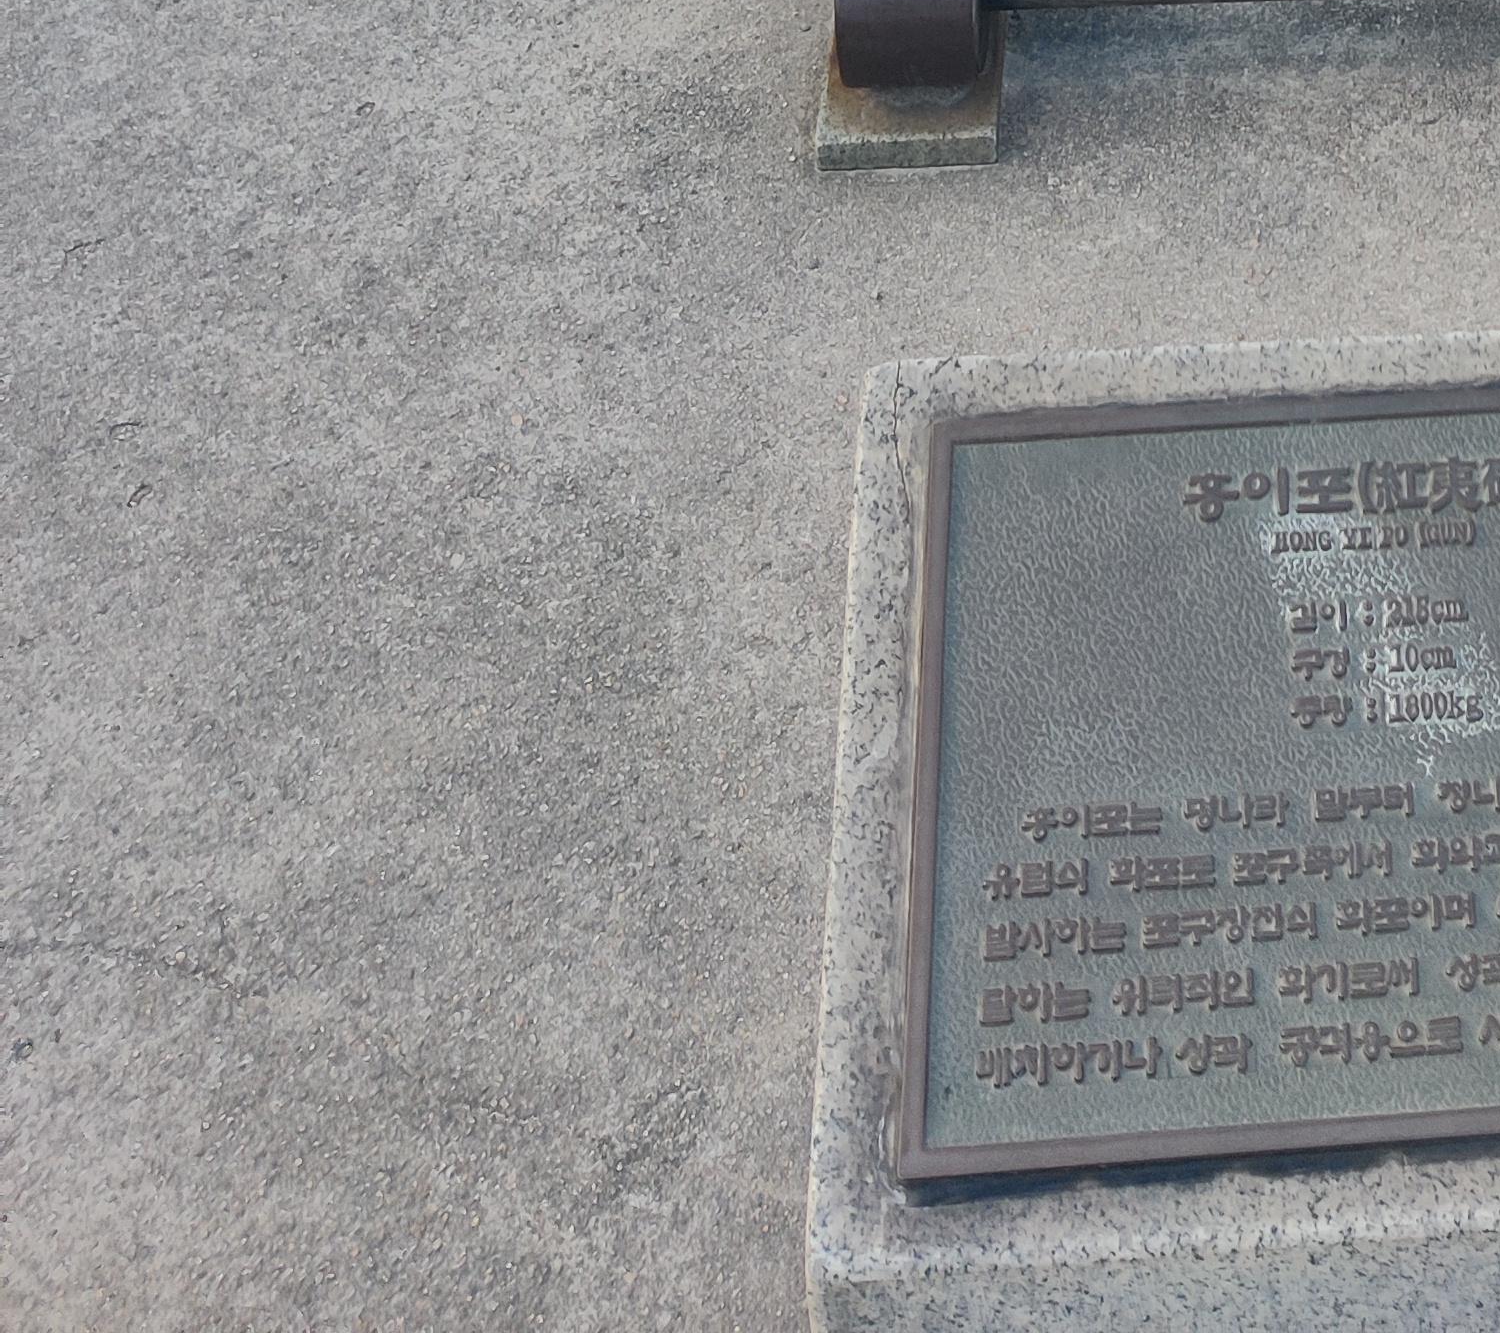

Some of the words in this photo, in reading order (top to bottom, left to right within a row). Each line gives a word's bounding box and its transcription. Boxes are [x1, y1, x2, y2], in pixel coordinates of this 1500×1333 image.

[1271, 529, 1332, 554] HONG
[1340, 527, 1372, 550] YI
[1380, 525, 1408, 548] PO
[1418, 519, 1477, 548] (GUN)
[1289, 600, 1348, 633] 길이
[1291, 645, 1350, 681] 구경
[1389, 643, 1457, 673] 10cm
[1290, 694, 1353, 729] 중량
[1389, 690, 1485, 724] 1800kg
[1021, 802, 1163, 839] 홍이포는
[1184, 792, 1290, 832] 명나라
[1314, 781, 1414, 821] 말부터
[982, 855, 1089, 899] 유럽식
[1108, 853, 1216, 892] 화포로
[982, 916, 1128, 962] 발사하는
[1141, 901, 1318, 948] 포구장전식
[1336, 892, 1476, 936] 화포이며
[979, 980, 1092, 1027] 달하는
[1112, 967, 1255, 1016] 위력적인
[1278, 956, 1420, 1004] 화기로써
[976, 1036, 1164, 1088] 배치하거나
[1176, 1033, 1254, 1076] 성곽
[1278, 1015, 1464, 1067] 공격용으로
